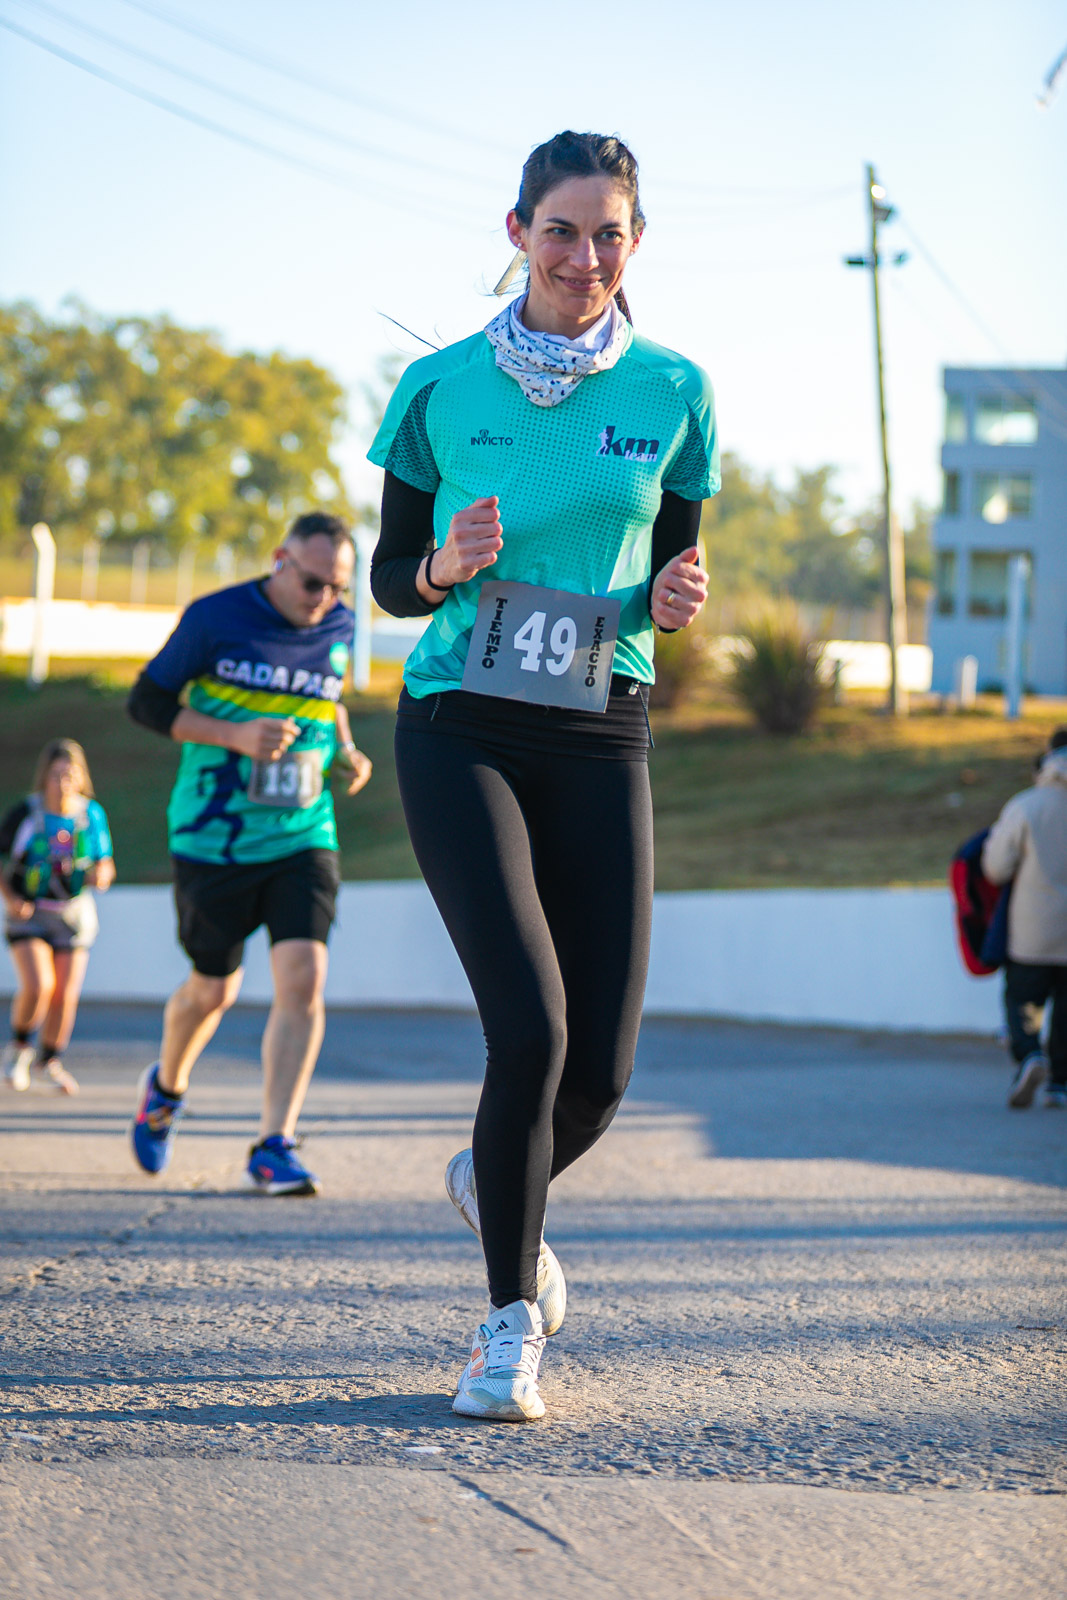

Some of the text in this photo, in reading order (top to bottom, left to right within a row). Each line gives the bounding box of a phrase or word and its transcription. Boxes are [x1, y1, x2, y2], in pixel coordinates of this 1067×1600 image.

[470, 436, 513, 446] INVICTO
[600, 425, 659, 456] km
[624, 450, 658, 462] team
[481, 597, 508, 669] TIEMPO
[513, 611, 577, 676] 49
[584, 616, 605, 687] EXACTO
[215, 658, 290, 691] CADA
[263, 761, 312, 796] 131
